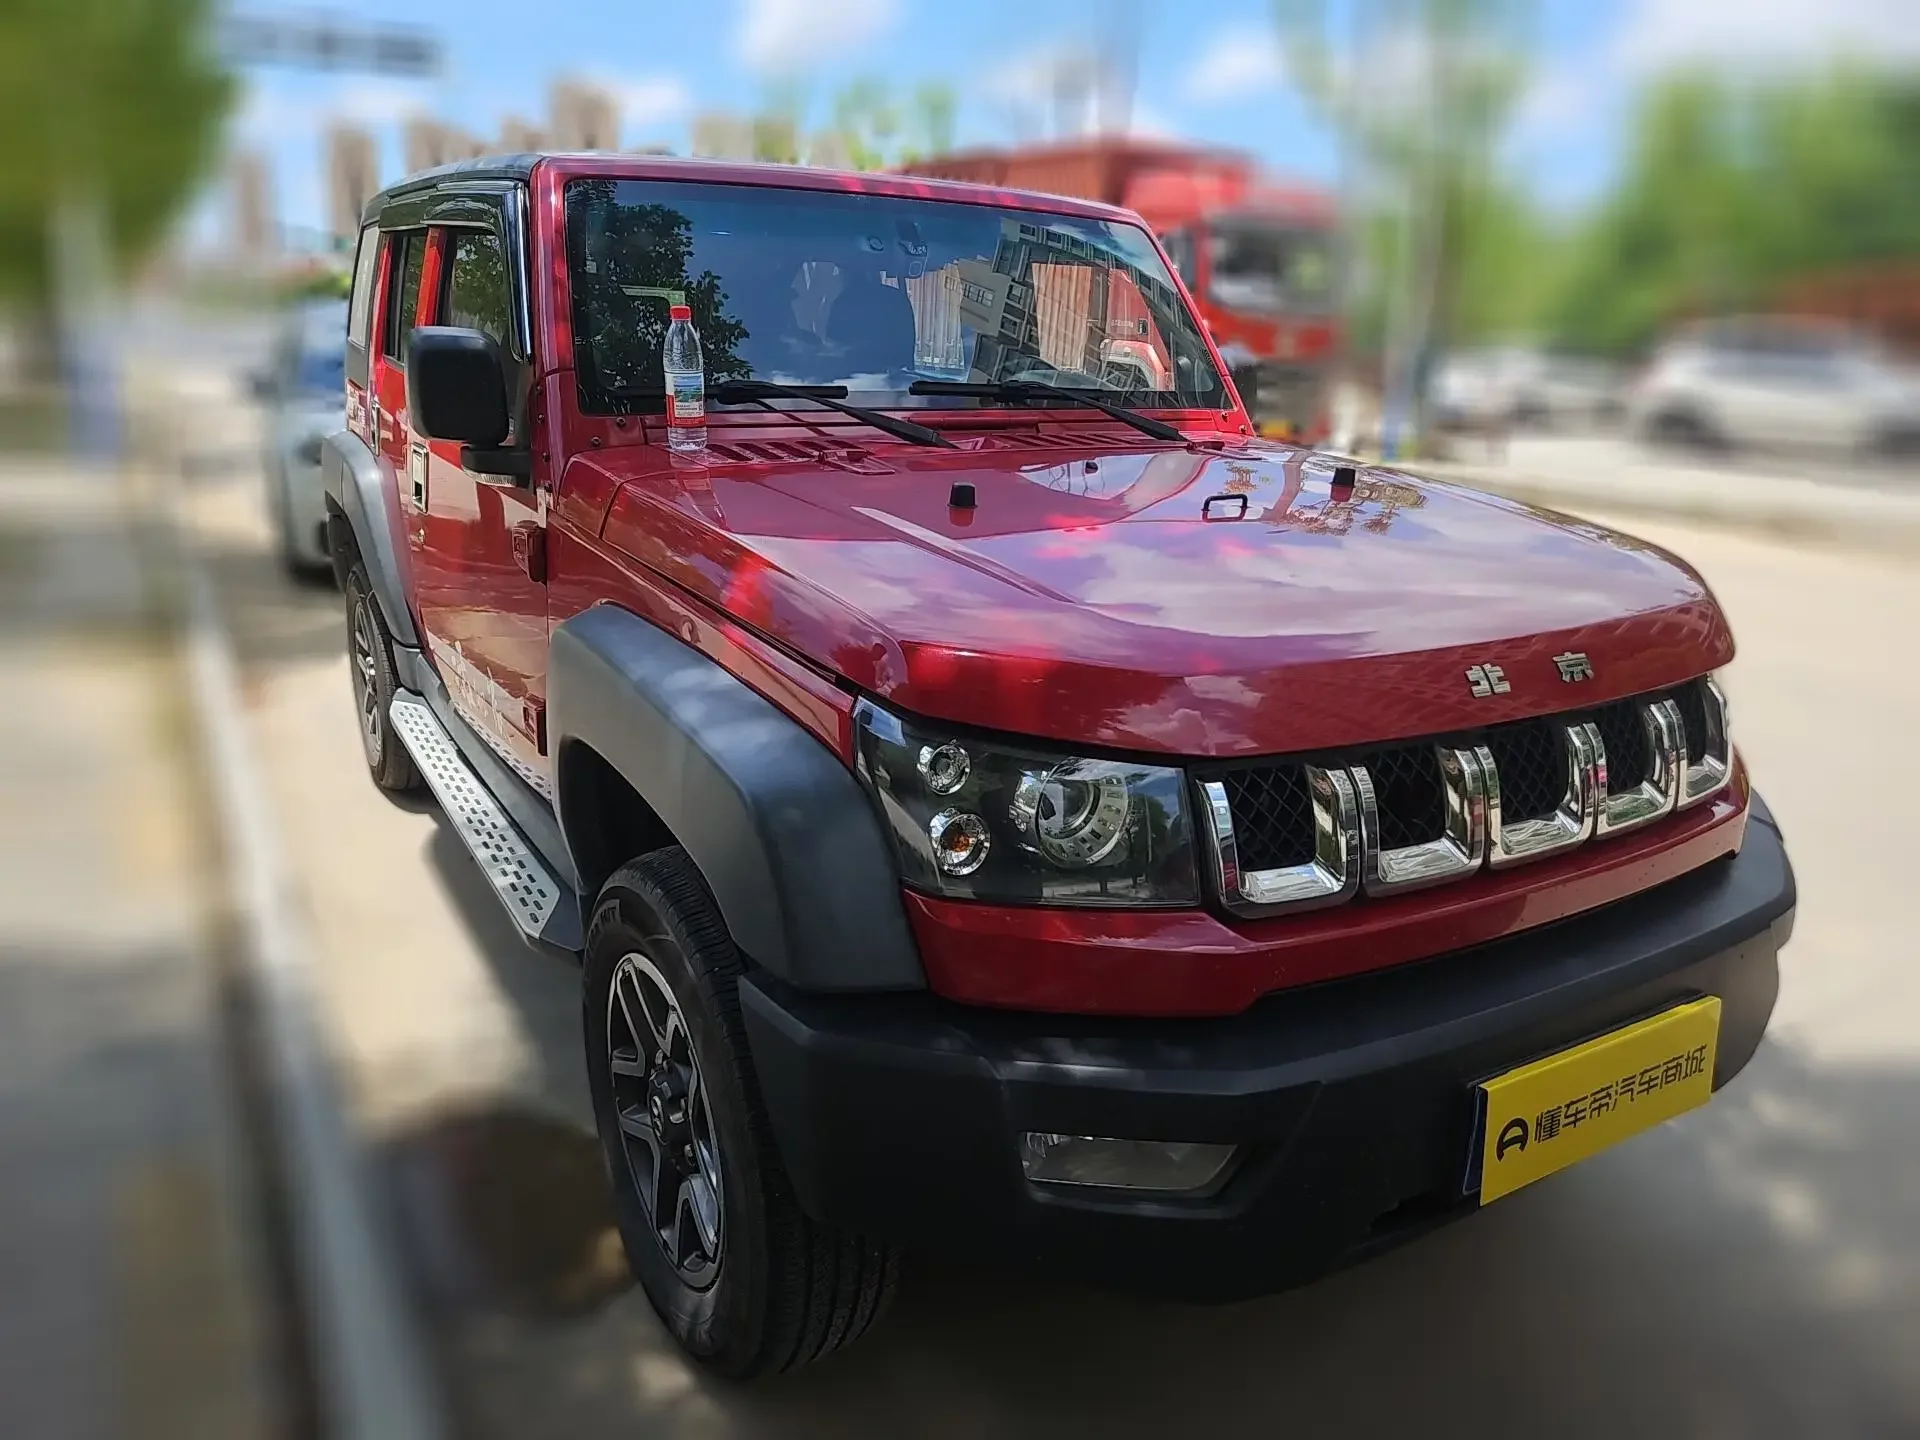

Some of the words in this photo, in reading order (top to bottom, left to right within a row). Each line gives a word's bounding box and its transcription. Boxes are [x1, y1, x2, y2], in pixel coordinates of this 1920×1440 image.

[1465, 652, 1594, 698] 北京
[1533, 1043, 1707, 1144] 懂车帝汽车商城
